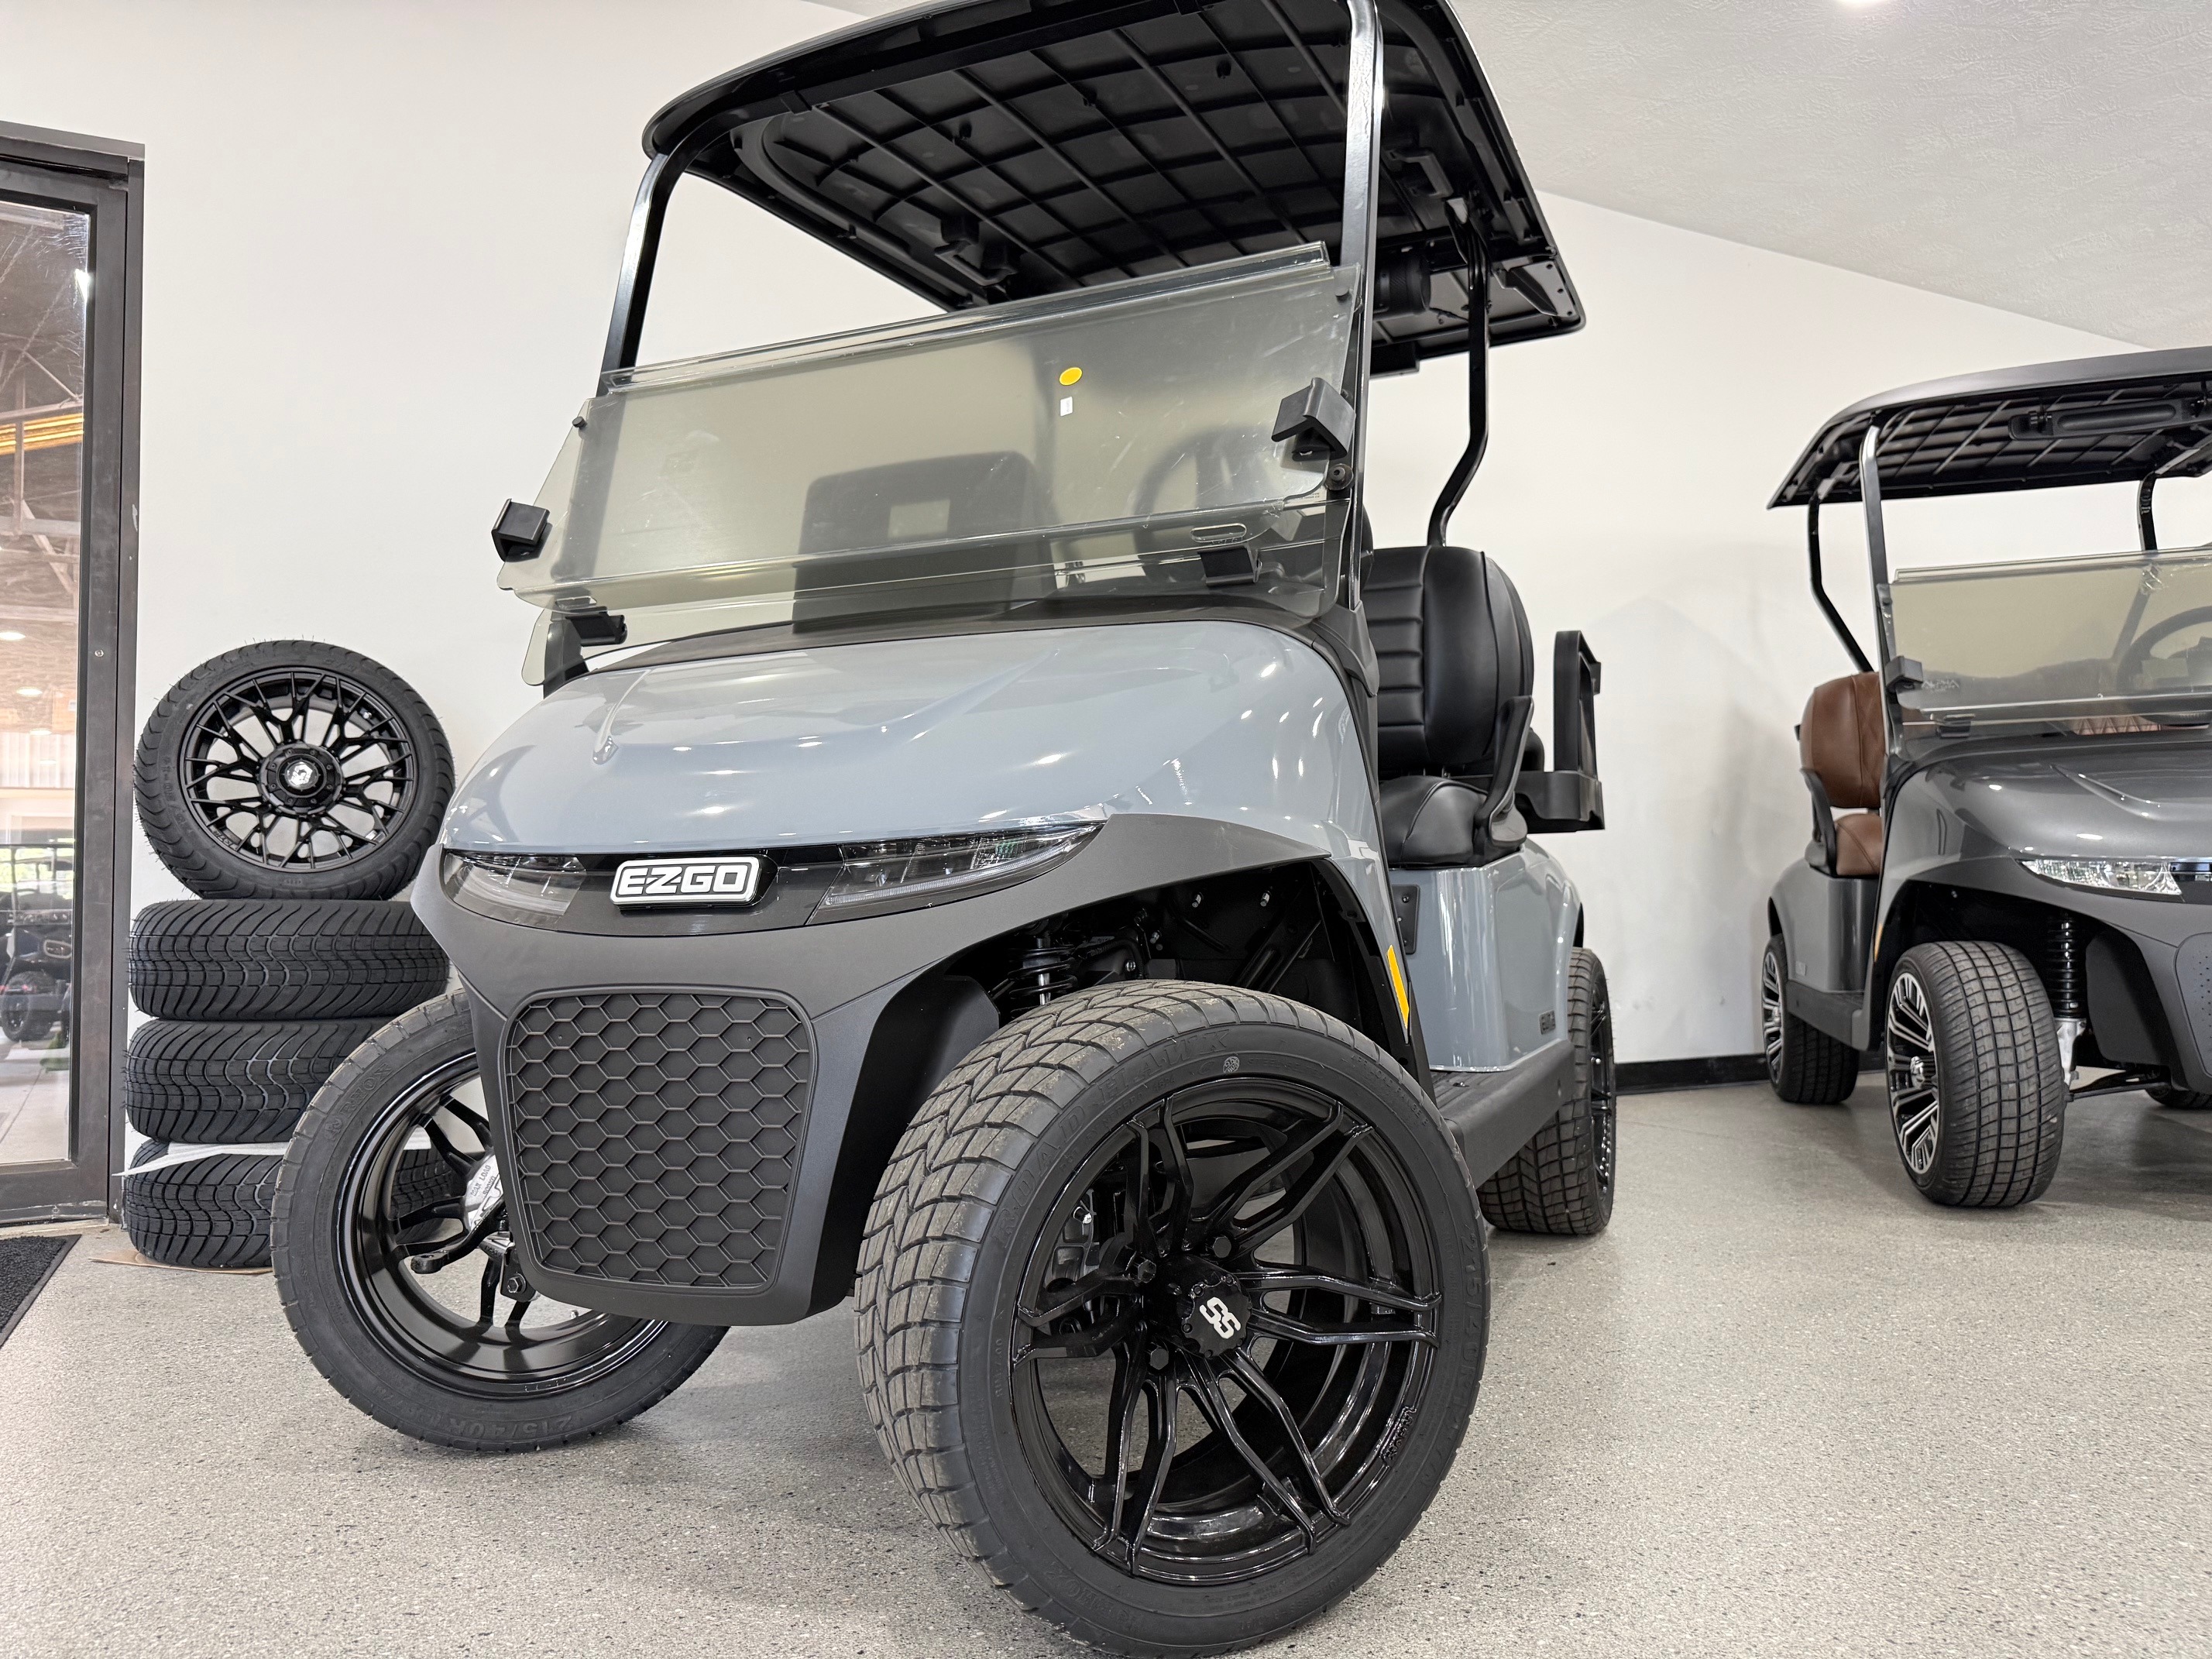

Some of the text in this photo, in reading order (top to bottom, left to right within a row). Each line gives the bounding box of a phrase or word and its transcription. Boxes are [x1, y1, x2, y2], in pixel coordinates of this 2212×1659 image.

[618, 864, 748, 895] EZGO
[338, 1062, 393, 1118] RHOX
[991, 1106, 1085, 1248] ROAD
[1095, 1029, 1230, 1106] HAWK
[479, 1165, 492, 1182] LOAD
